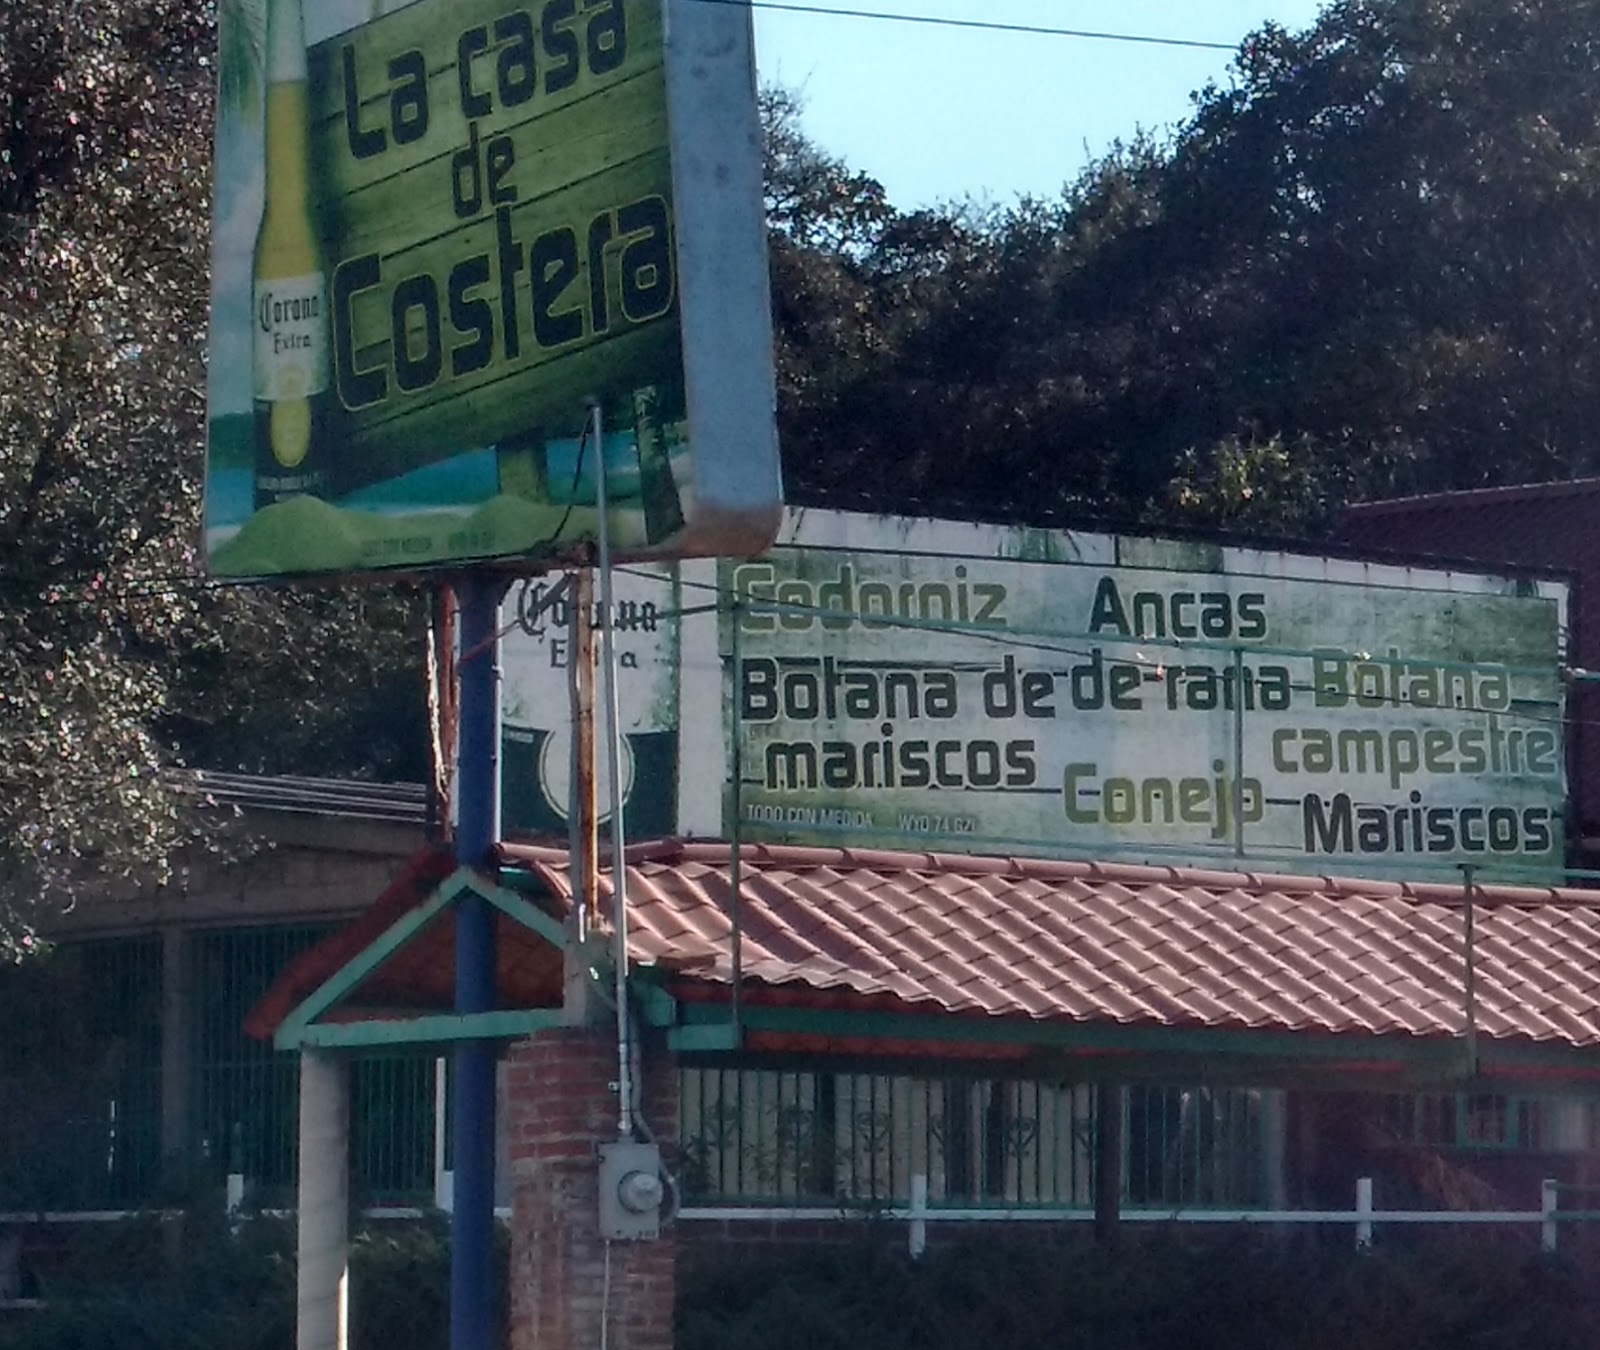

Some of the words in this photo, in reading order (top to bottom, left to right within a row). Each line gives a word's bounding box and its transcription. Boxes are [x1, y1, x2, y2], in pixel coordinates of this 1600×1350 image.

[342, 43, 429, 160] La
[457, 0, 628, 118] casa
[452, 121, 519, 220] de
[332, 195, 676, 412] Costera
[517, 573, 658, 641] Coona
[734, 562, 1008, 633] Codorniz
[1088, 575, 1268, 640] Ancas
[740, 655, 957, 721] Botana
[982, 655, 1057, 719] de
[1072, 648, 1143, 711] de
[1165, 665, 1292, 711] rana
[1312, 648, 1511, 711] Botana
[765, 723, 1037, 791] mariscos
[1272, 712, 1556, 789] campestre
[1063, 759, 1264, 839] Conejo
[1302, 790, 1551, 854] Mariscos
